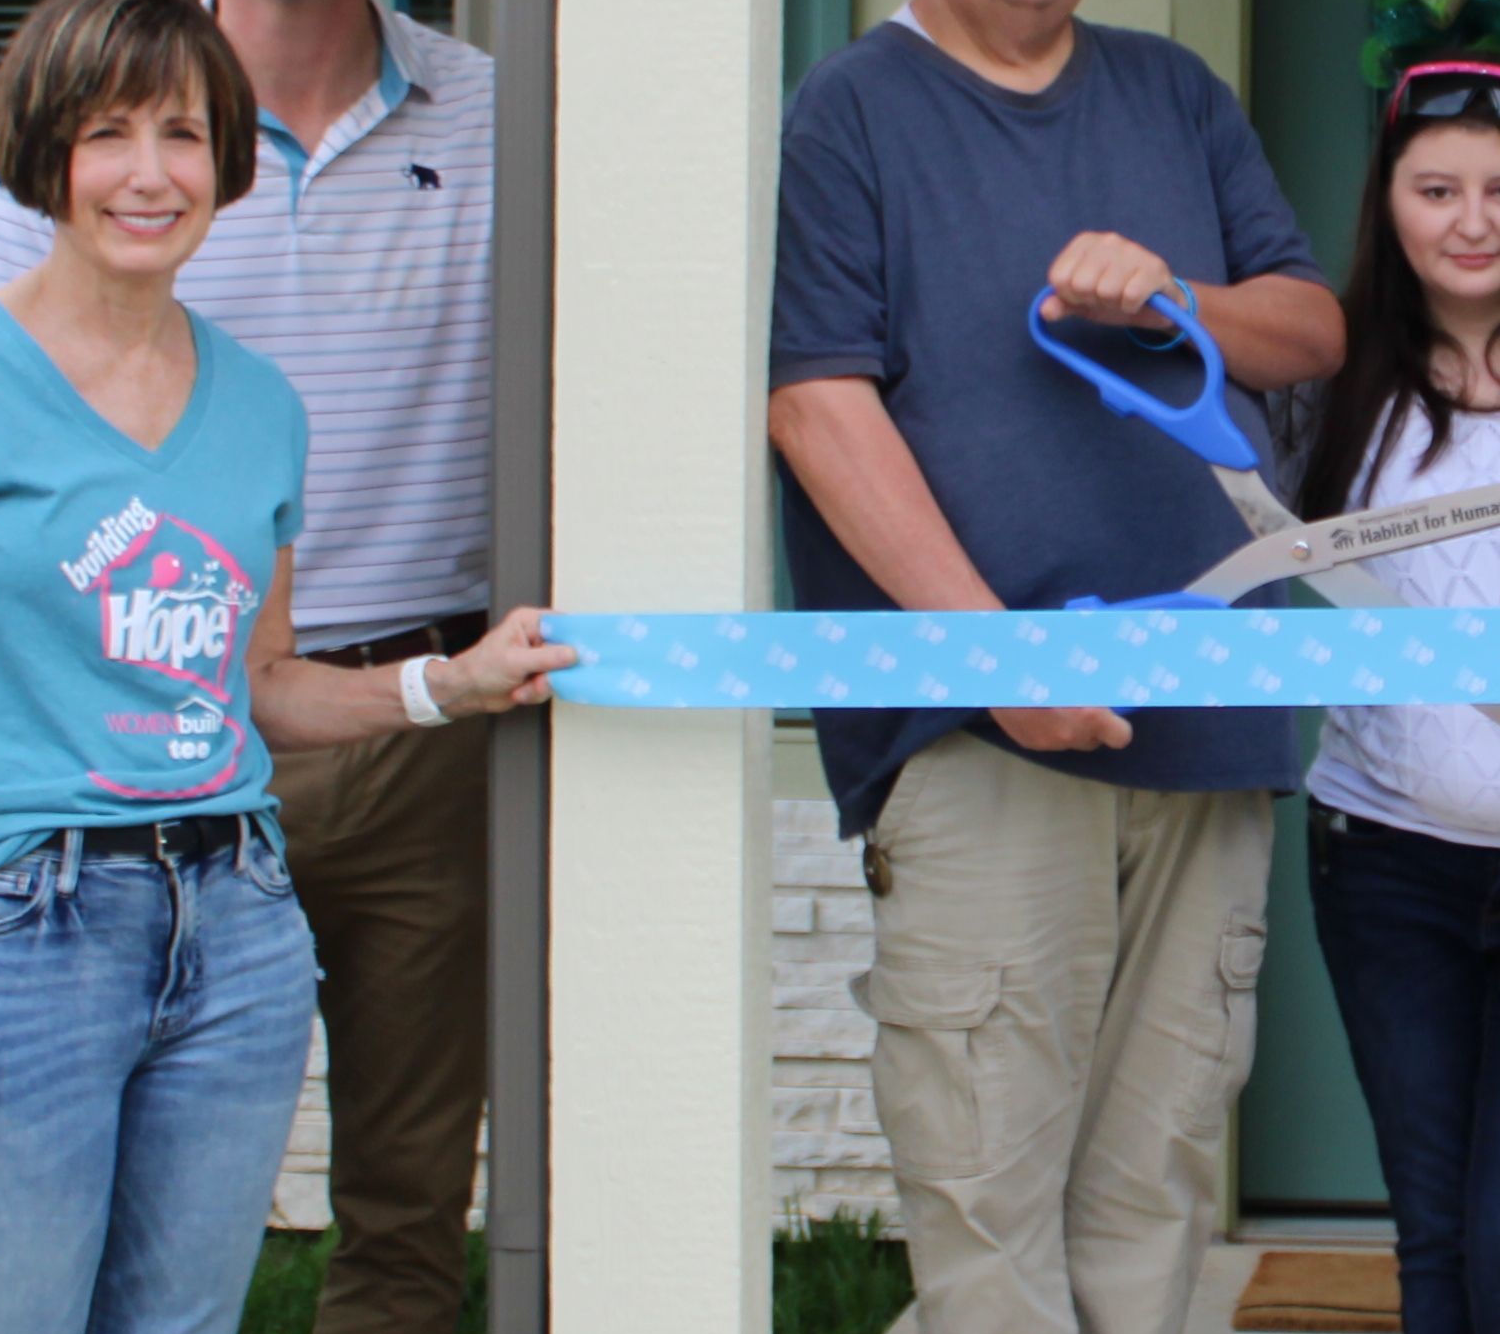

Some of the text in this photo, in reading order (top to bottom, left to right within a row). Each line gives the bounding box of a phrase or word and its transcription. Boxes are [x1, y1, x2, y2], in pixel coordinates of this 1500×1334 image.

[61, 496, 157, 592] building
[1359, 519, 1420, 546] Habitat
[1423, 514, 1448, 531] for
[108, 589, 230, 670] Hope
